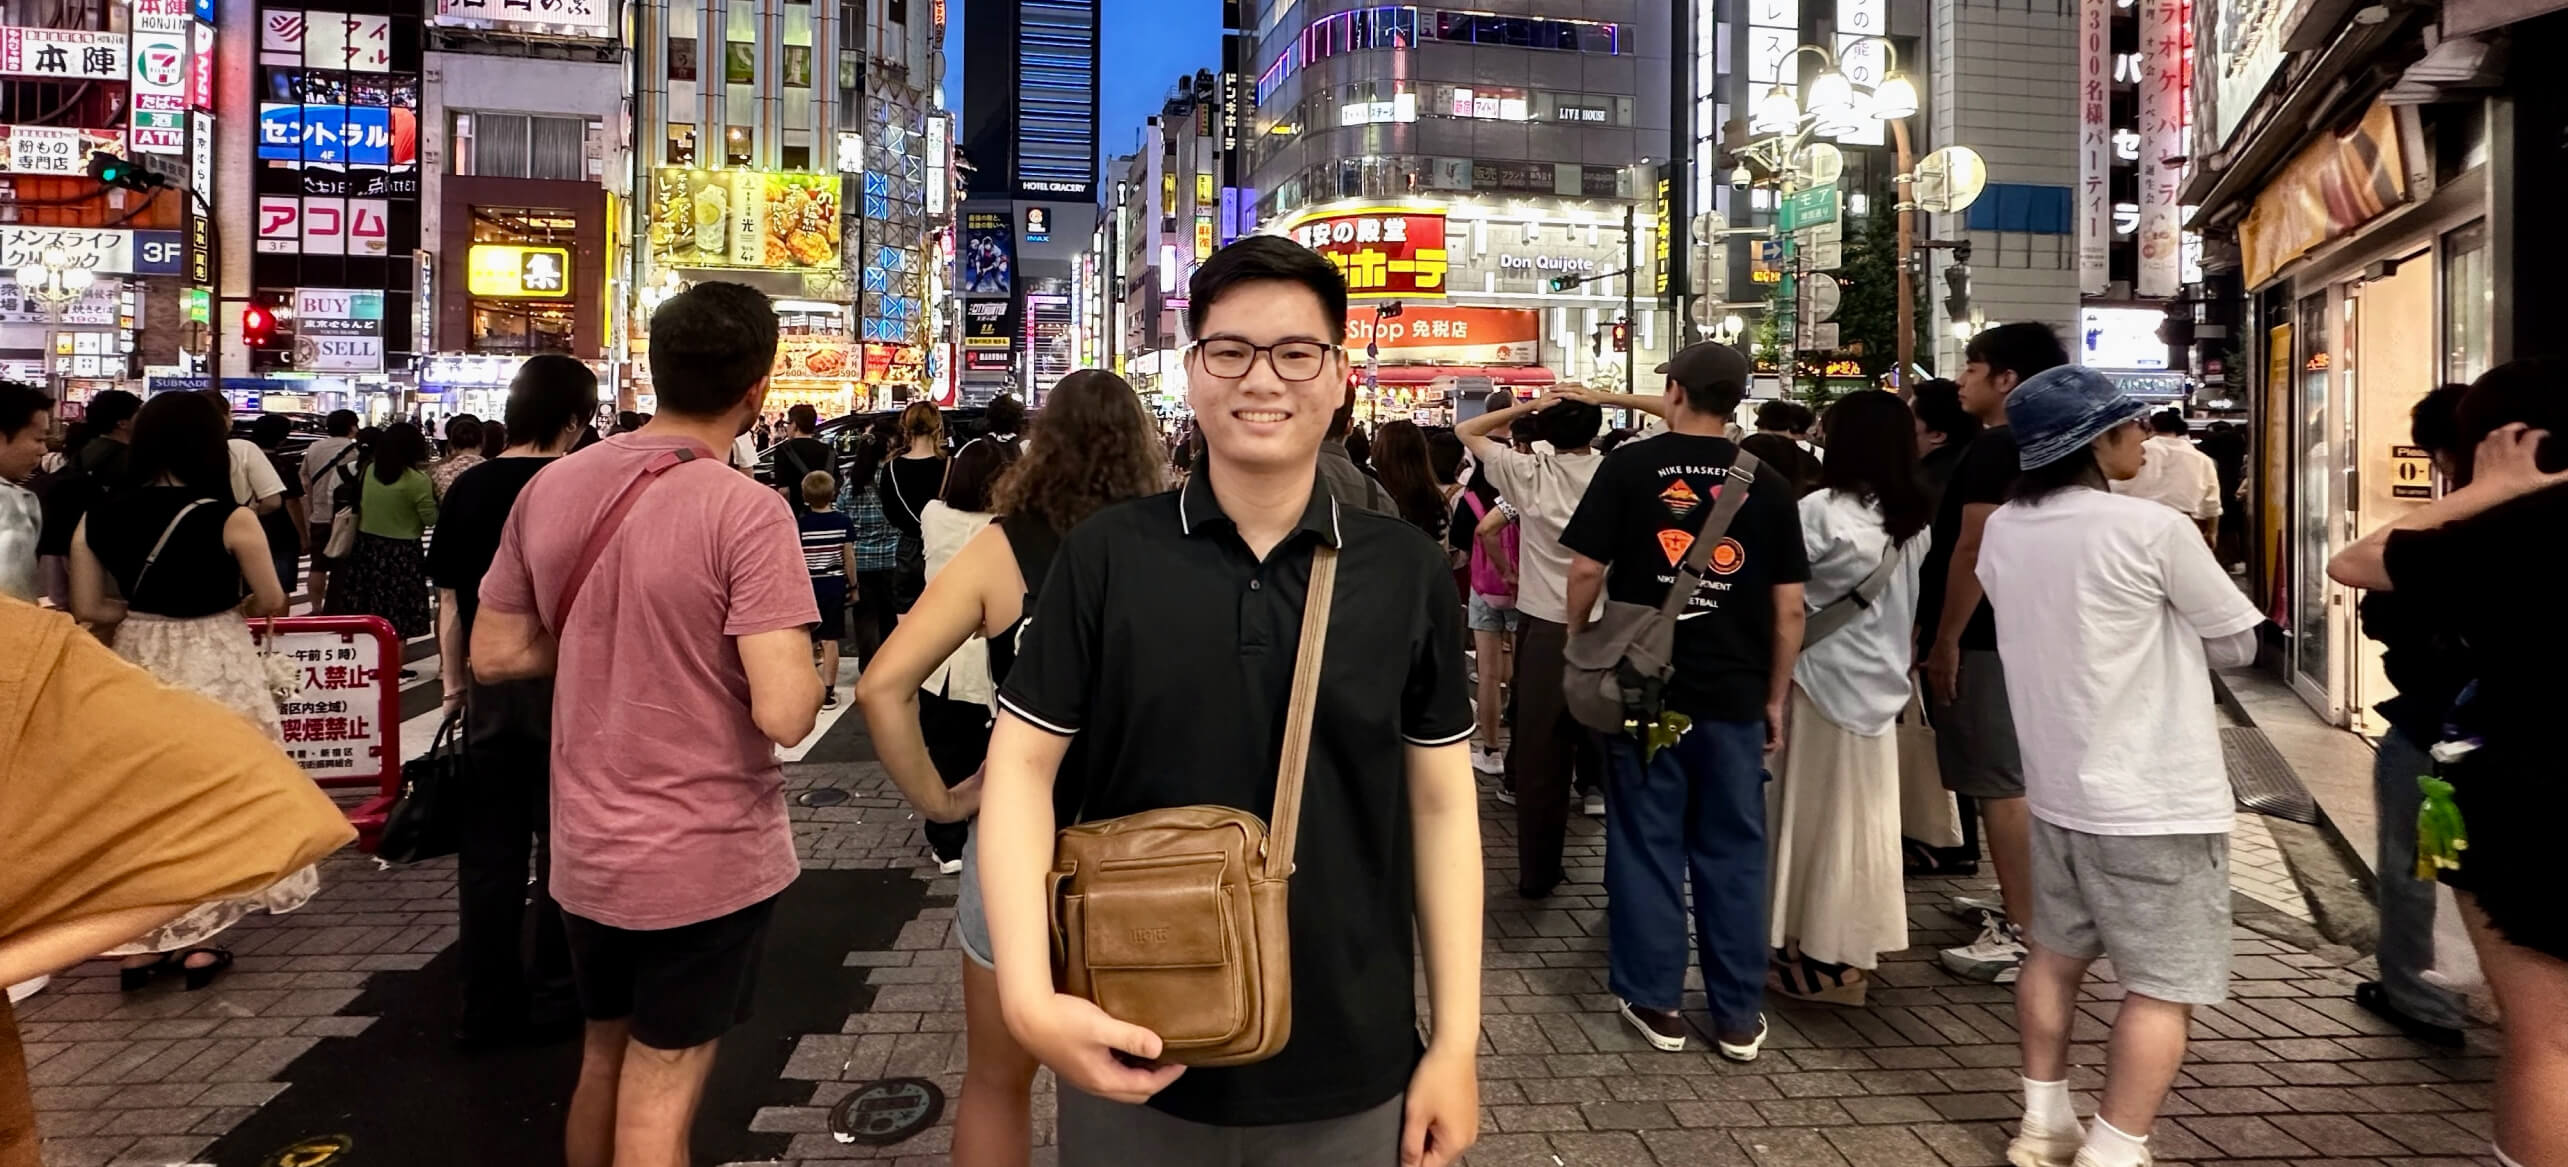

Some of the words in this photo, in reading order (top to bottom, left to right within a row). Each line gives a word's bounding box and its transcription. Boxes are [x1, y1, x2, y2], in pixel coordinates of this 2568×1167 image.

[142, 17, 185, 29] HONJIN
[36, 44, 116, 75] 本陣
[142, 96, 184, 110] たばこ
[152, 115, 172, 127] 酒
[1559, 108, 1580, 120] LIVE
[1582, 109, 1606, 121] HOUSE
[2085, 0, 2103, 237] 300名様パーティー
[139, 130, 183, 145] ATM
[263, 118, 389, 149] セントラル
[18, 140, 69, 154] 粉もの
[320, 150, 336, 159] 4F
[18, 156, 69, 170] 専門店
[1022, 181, 1049, 192] HOTEL
[1050, 182, 1086, 193] GRACERY
[1801, 188, 1831, 206] モア
[261, 205, 386, 237] アコム
[741, 218, 755, 233] 光
[8, 229, 122, 249] メンズライフ
[269, 241, 288, 251] 3F
[8, 250, 100, 269] クリック
[143, 243, 181, 263] 3F
[1500, 254, 1532, 268] Don
[1536, 256, 1594, 273] Quijote
[303, 297, 348, 313] BUY
[1350, 319, 1405, 344] Shop
[1412, 321, 1468, 339] 免税店
[322, 341, 376, 357] SELL
[839, 368, 856, 379] 590
[1657, 465, 1682, 478] NIKE
[295, 664, 371, 690] 入禁止
